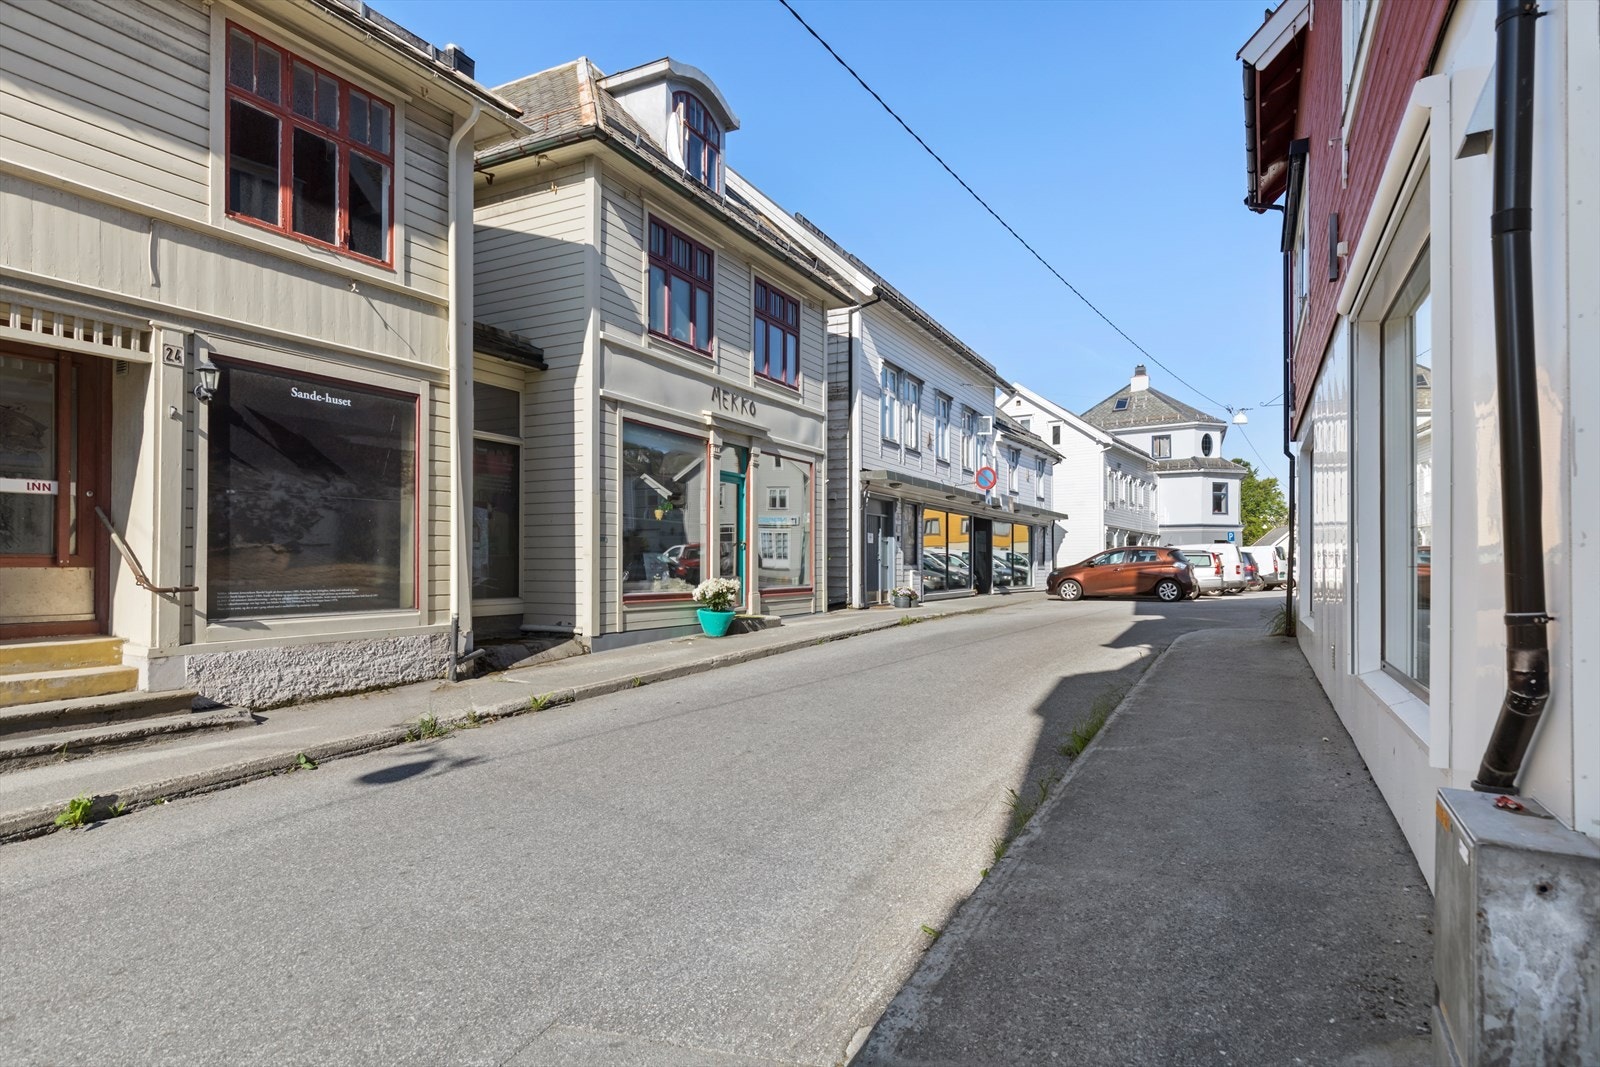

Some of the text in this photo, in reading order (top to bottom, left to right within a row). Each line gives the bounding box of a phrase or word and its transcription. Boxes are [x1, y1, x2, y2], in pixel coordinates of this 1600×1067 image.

[165, 347, 183, 364] 24
[290, 386, 352, 407] Sande-huset
[26, 481, 52, 492] INN
